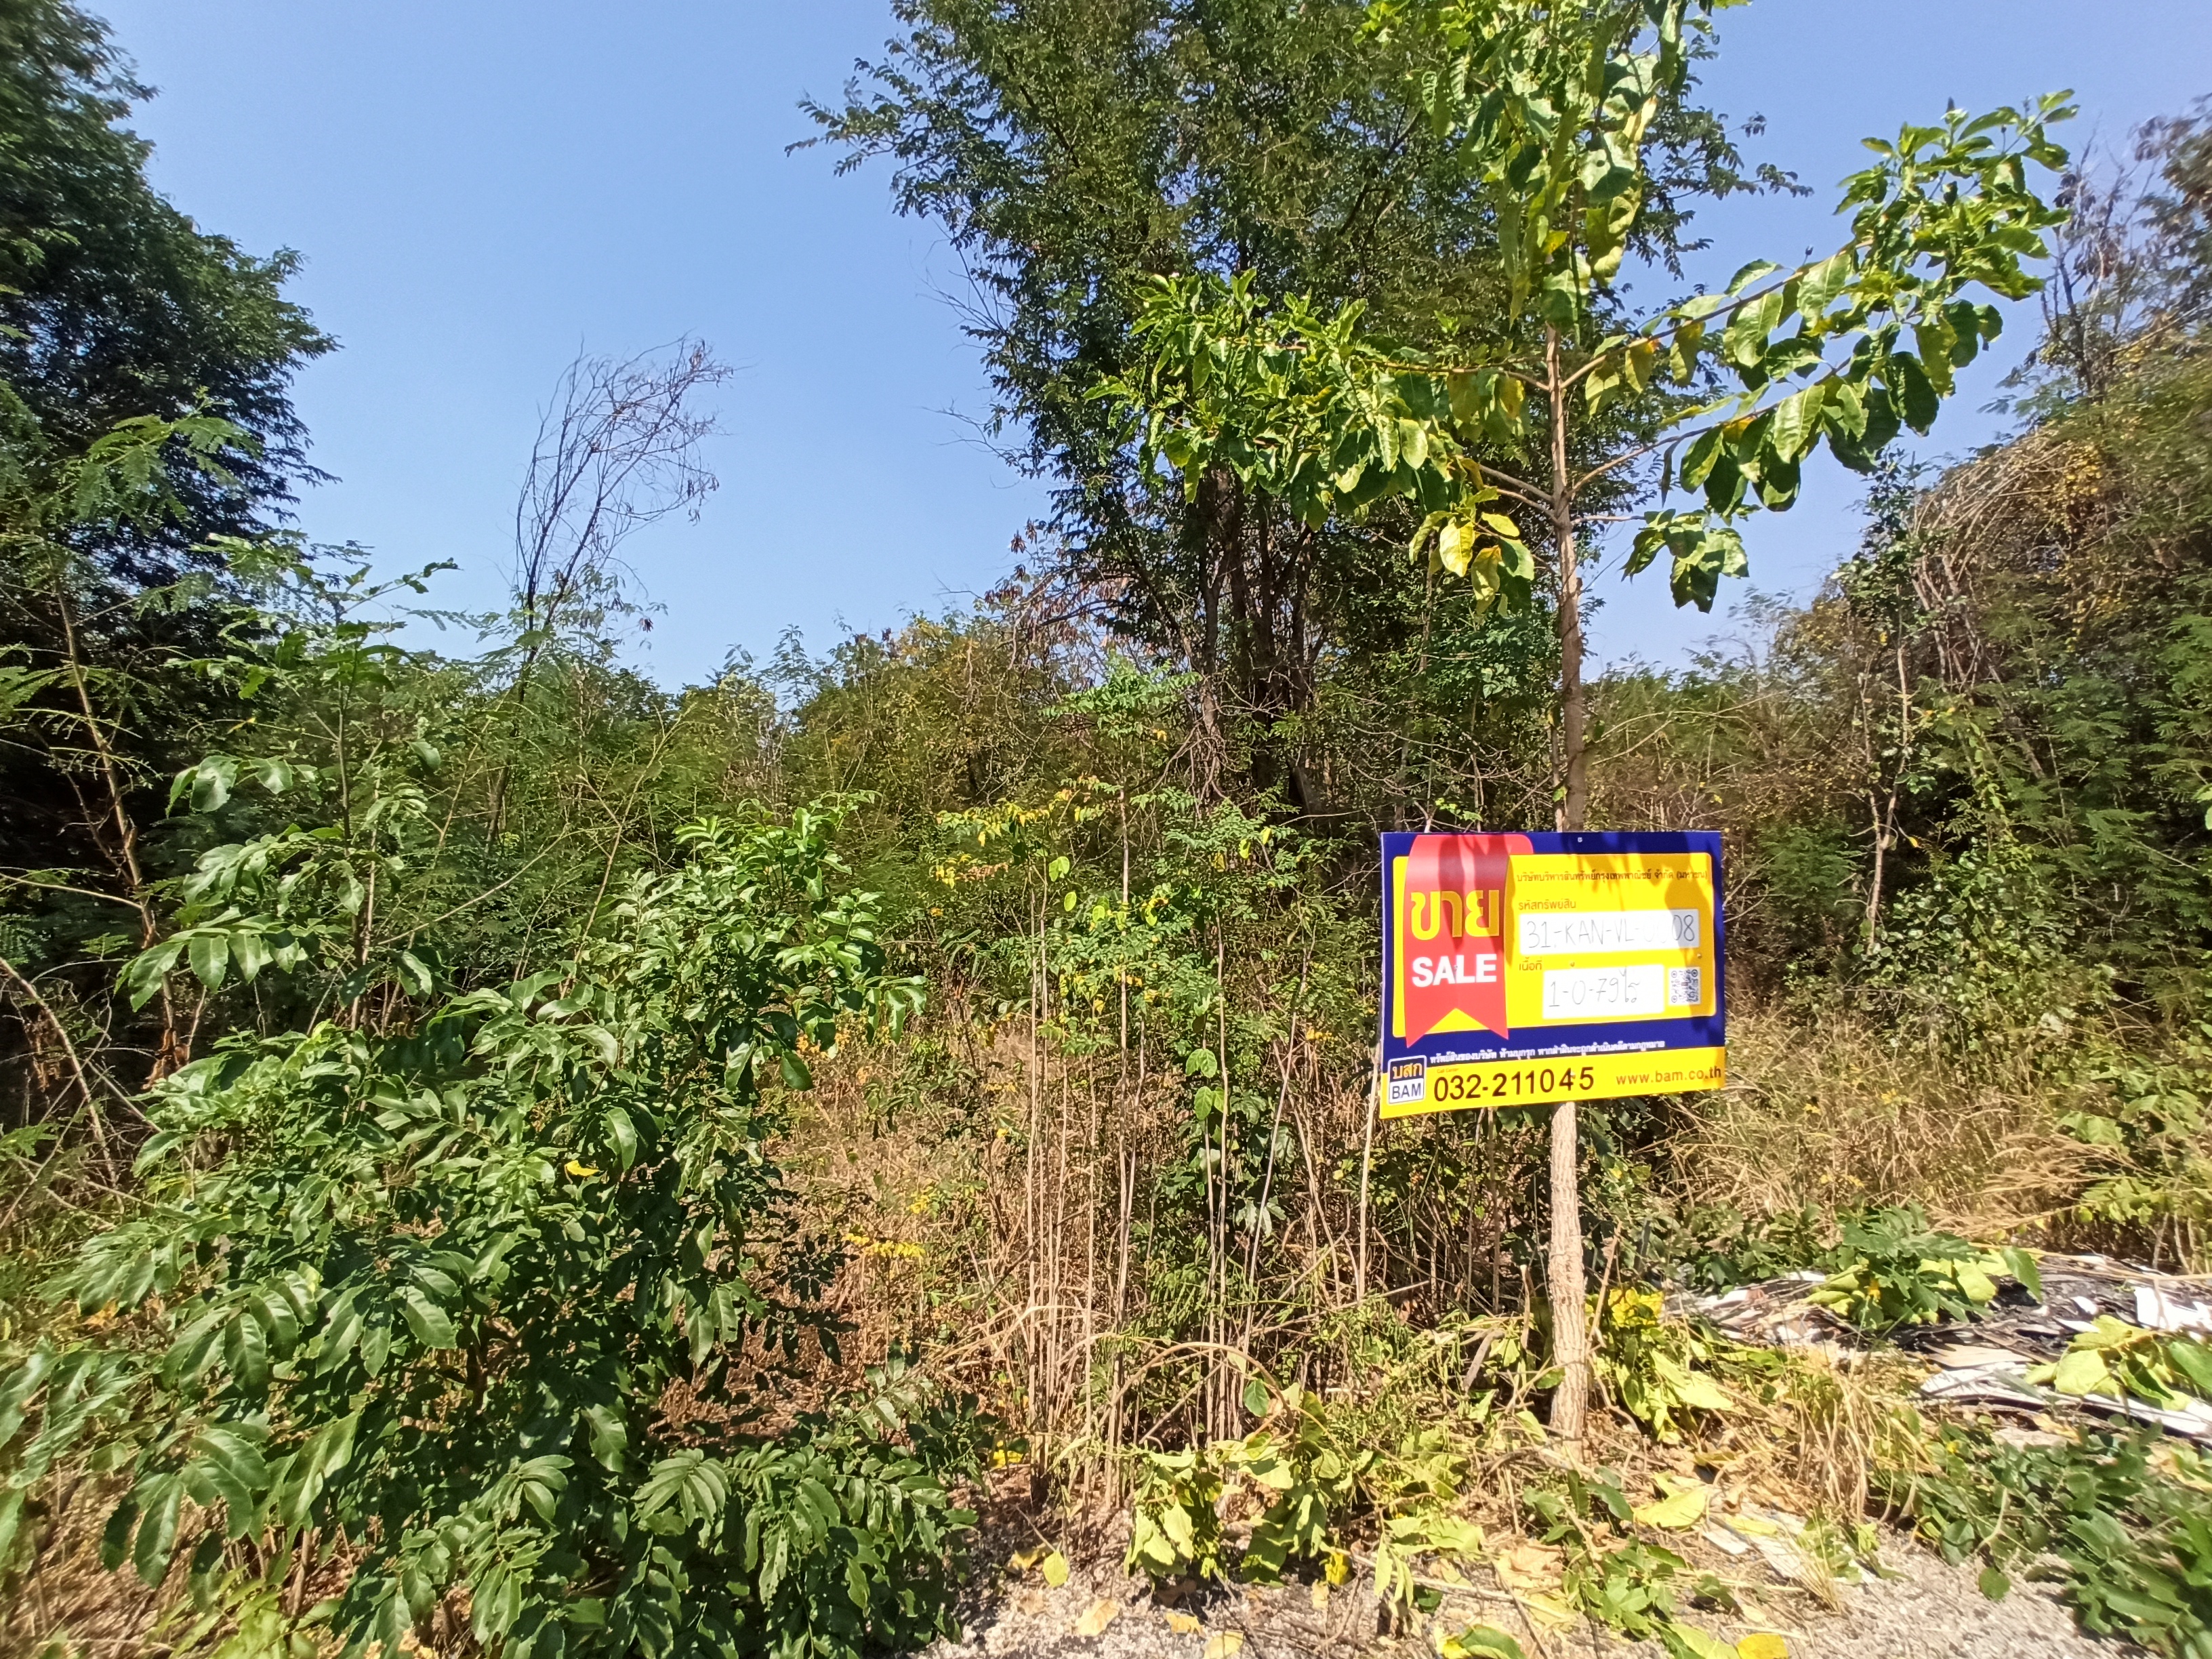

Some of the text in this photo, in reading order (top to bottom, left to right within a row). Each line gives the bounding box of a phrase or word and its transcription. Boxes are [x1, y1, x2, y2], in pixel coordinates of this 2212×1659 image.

[1410, 889, 1500, 941] ขาย
[1412, 954, 1497, 987] SALE
[1393, 1063, 1422, 1080] บสก
[1434, 1067, 1595, 1102] 032-211045
[1616, 1065, 1721, 1085] www.bam.co.th
[1392, 1083, 1422, 1099] BAM
